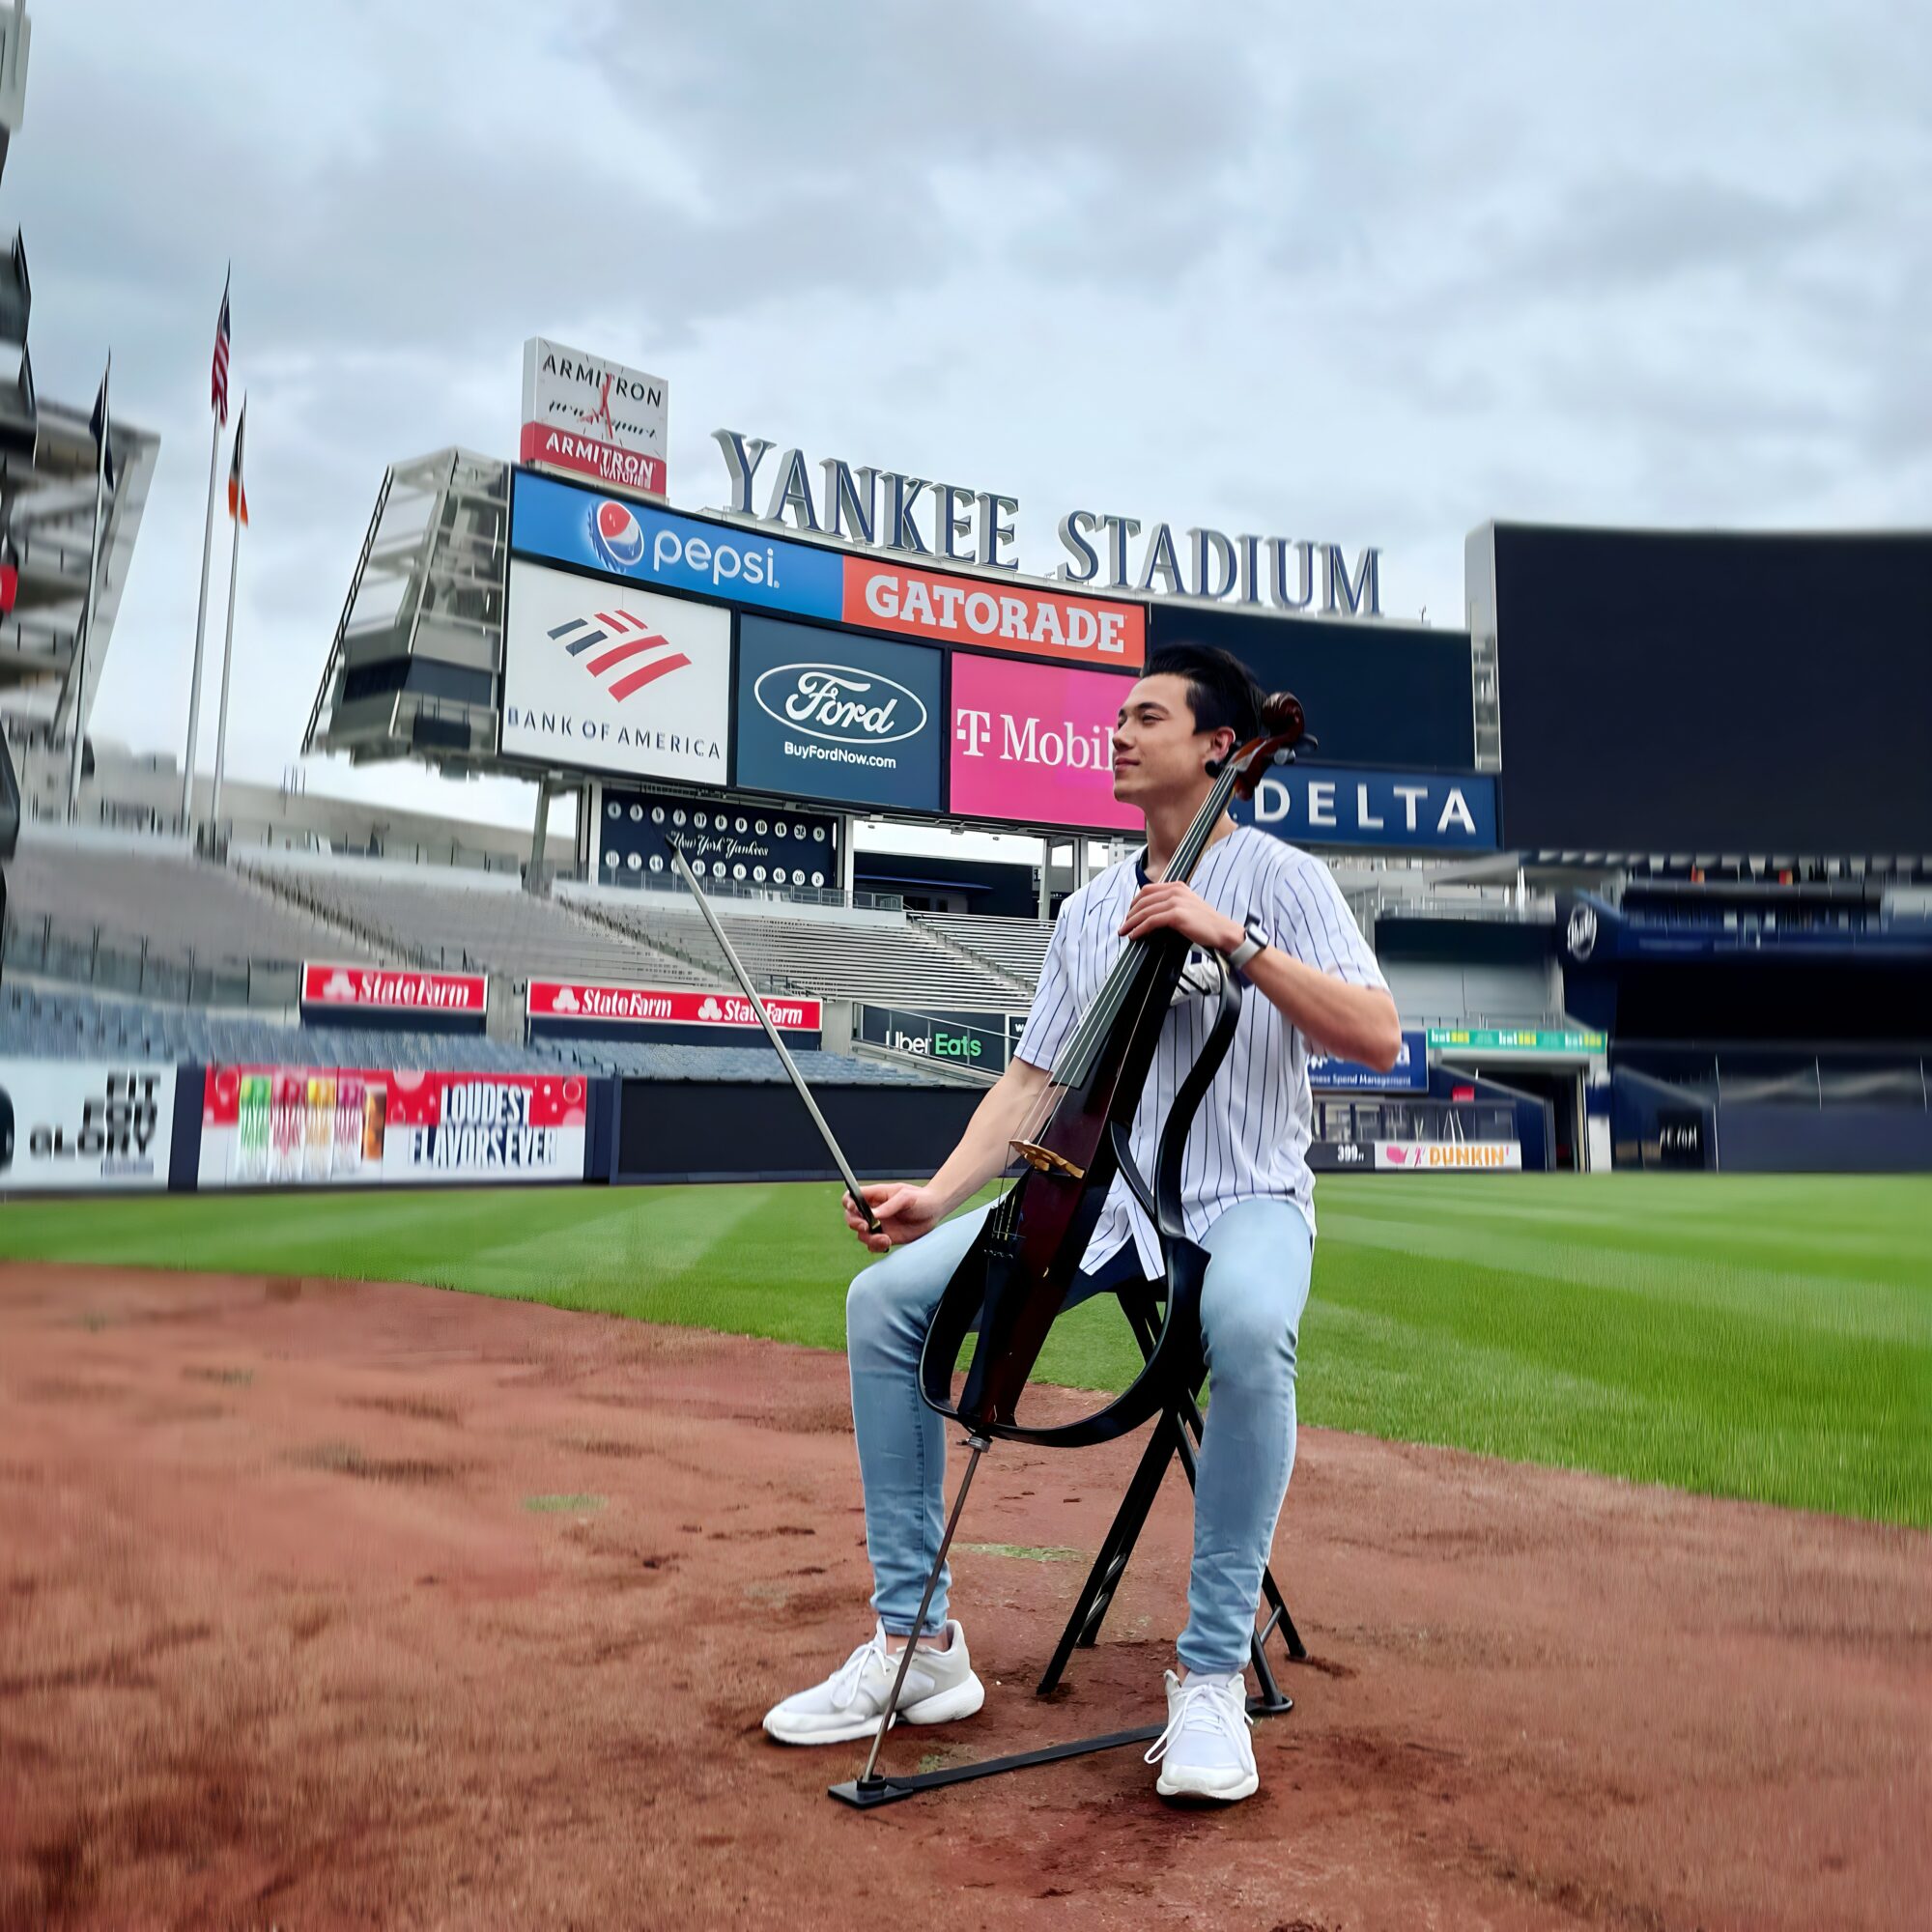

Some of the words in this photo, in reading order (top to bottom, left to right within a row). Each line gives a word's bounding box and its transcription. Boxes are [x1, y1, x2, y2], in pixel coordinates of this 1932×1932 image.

[543, 353, 662, 409] ARMITRON
[546, 432, 654, 479] ARMITRON
[710, 428, 1019, 572] YANKEE
[1058, 510, 1383, 617] STADIUM
[653, 528, 775, 587] pepsi
[865, 574, 1125, 654] GATORADE
[784, 670, 898, 734] Ford
[507, 706, 573, 737] BANK
[582, 719, 611, 742] OF
[617, 725, 721, 760] AMERICA
[783, 740, 896, 769] BuyFordNow.com
[999, 714, 1115, 771] Mobil
[1254, 778, 1477, 836] DELTA
[696, 833, 725, 857] York
[724, 837, 769, 860] Yankees
[885, 1030, 933, 1055] Uber
[935, 1033, 982, 1057] Eats
[440, 1082, 533, 1127] LOUDEST
[506, 1123, 557, 1167] EVER
[1429, 1145, 1509, 1167] DUNKIN'
